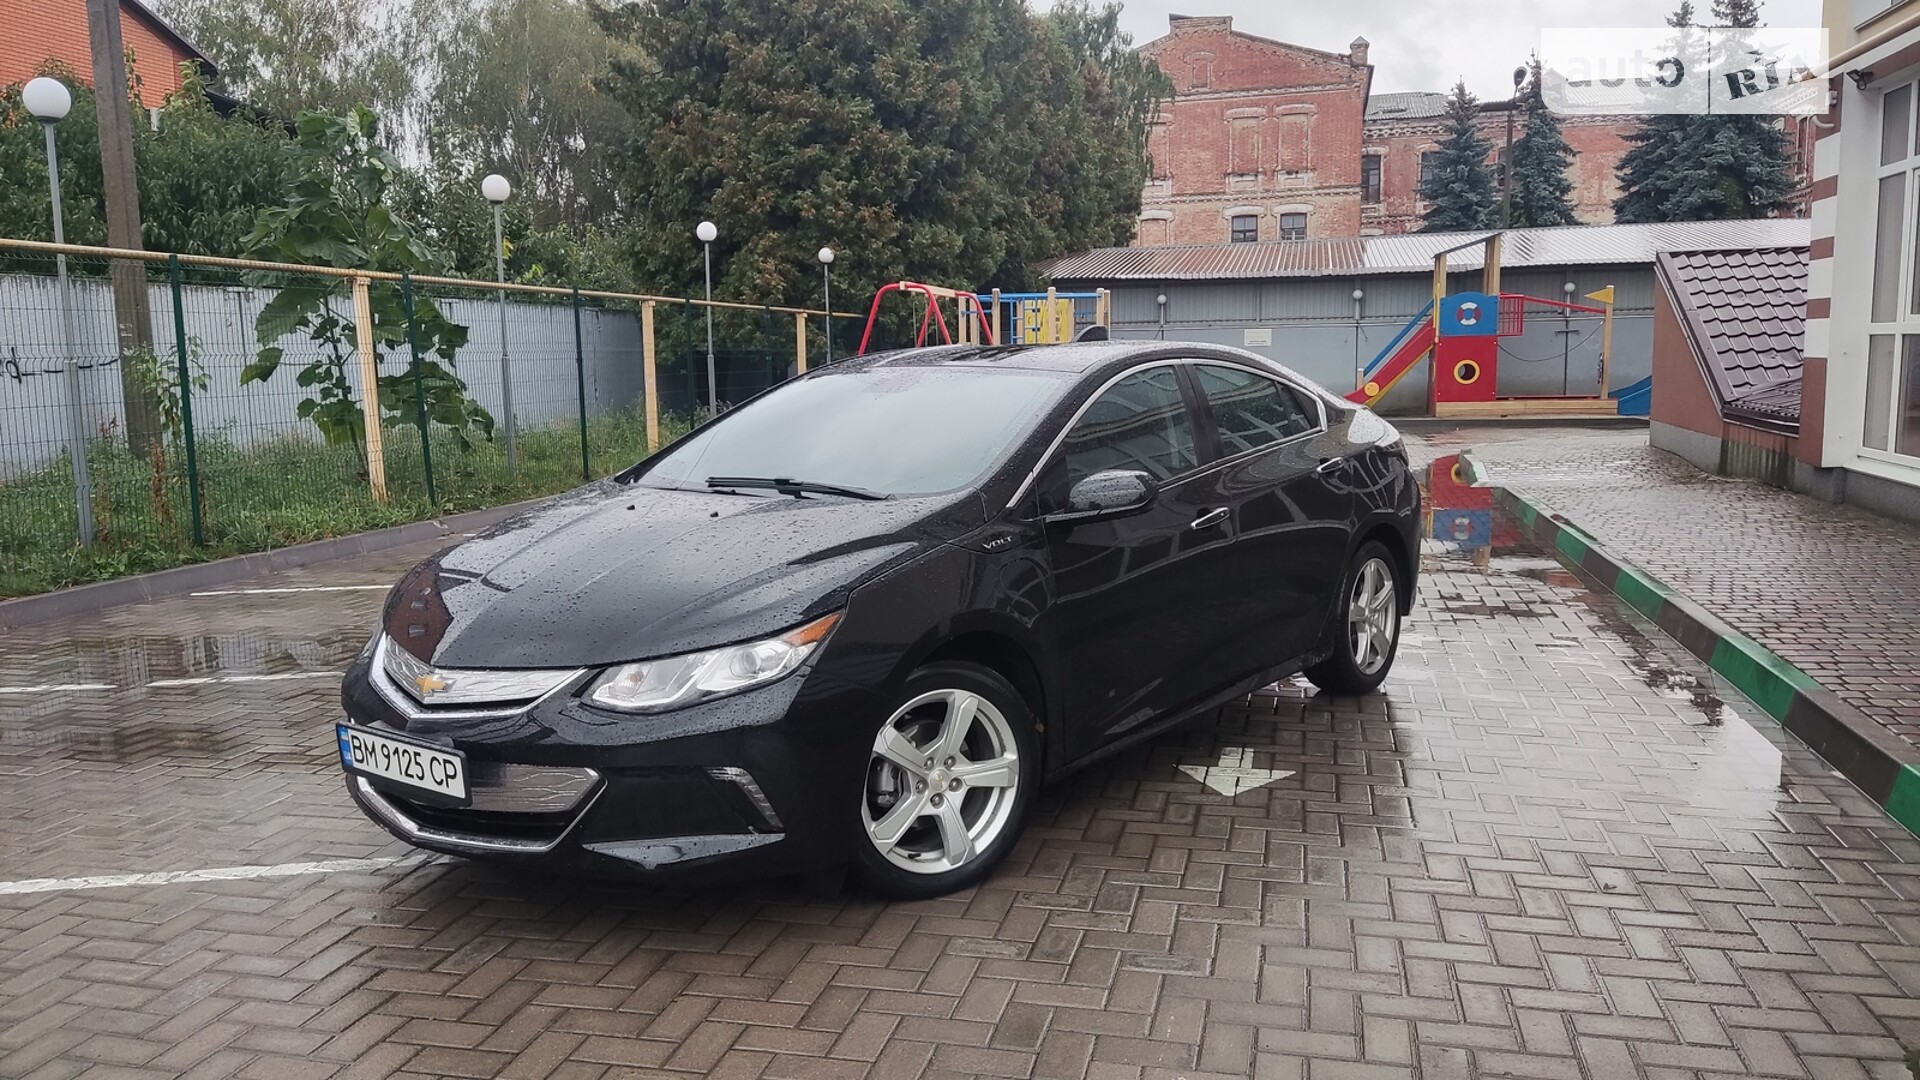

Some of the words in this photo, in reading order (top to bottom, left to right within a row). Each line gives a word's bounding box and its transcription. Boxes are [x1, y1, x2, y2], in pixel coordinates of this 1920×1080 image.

[982, 535, 1013, 549] VOLT
[351, 735, 379, 769] BM
[381, 743, 425, 781] 9125
[430, 756, 457, 788] CP
